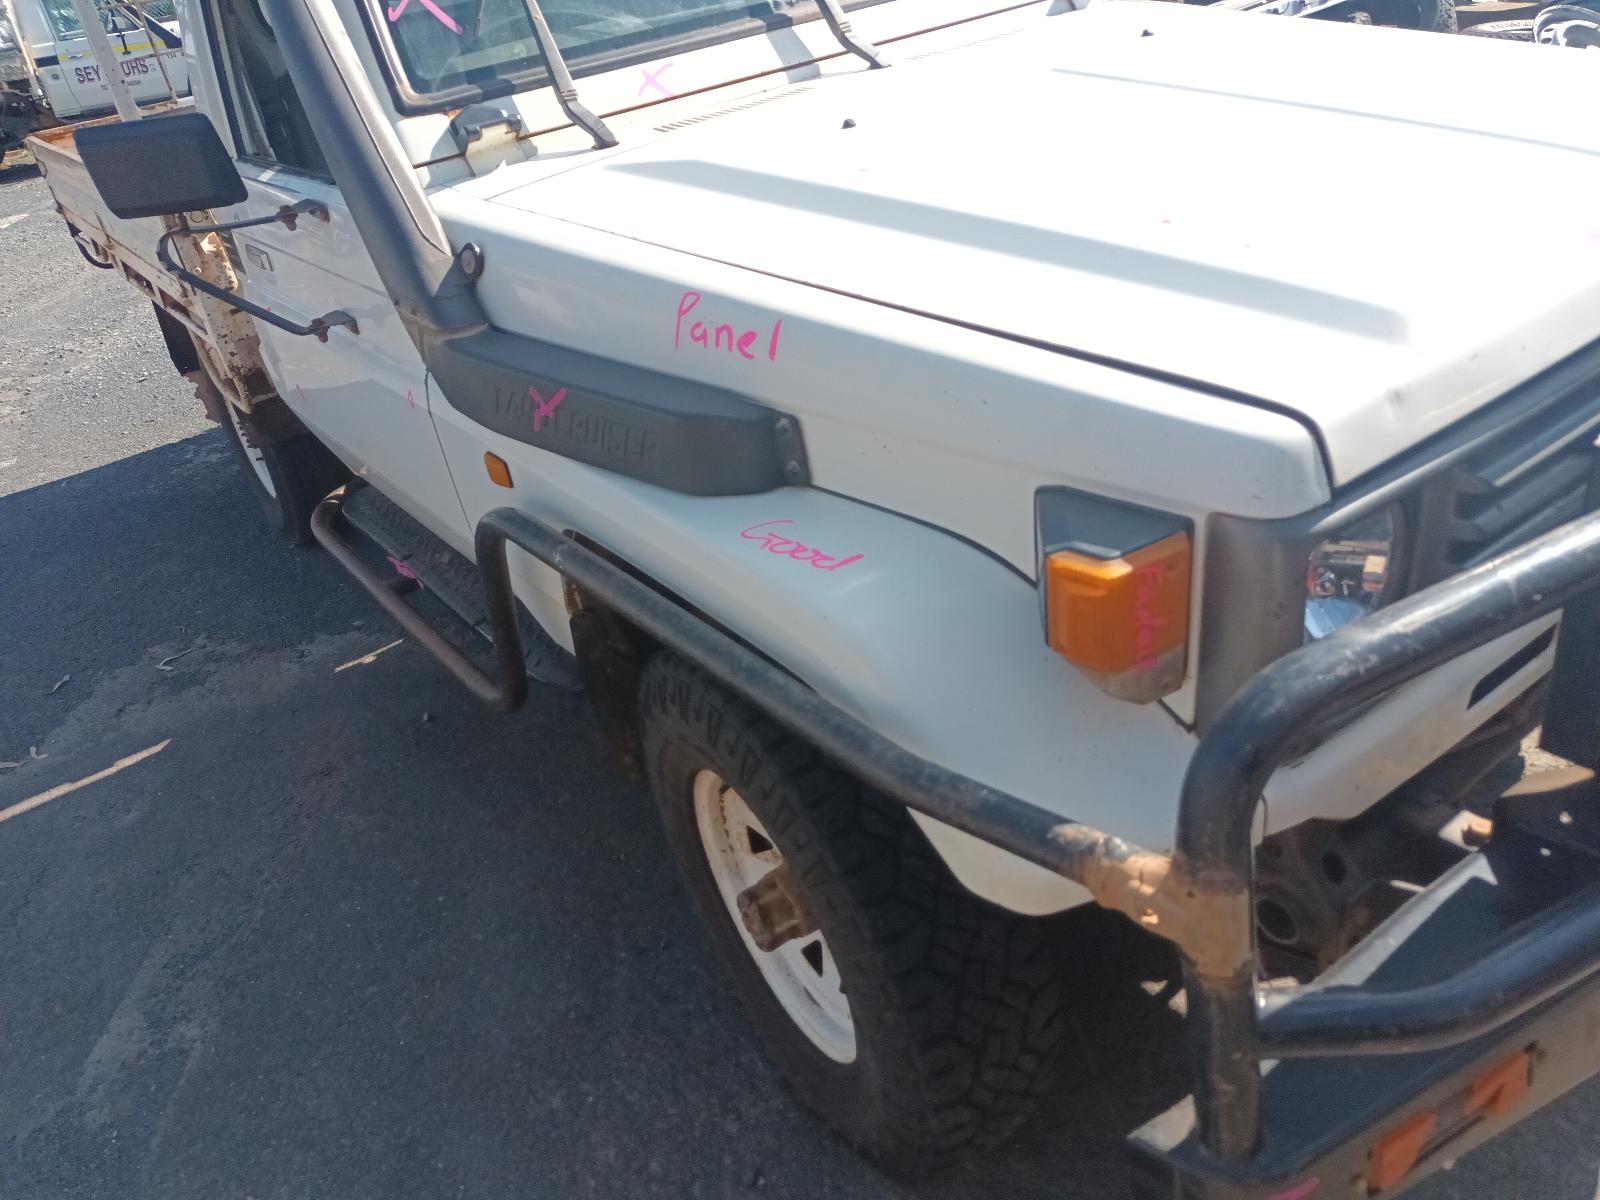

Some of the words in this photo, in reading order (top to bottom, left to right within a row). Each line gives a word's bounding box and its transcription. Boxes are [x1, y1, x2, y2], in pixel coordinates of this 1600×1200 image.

[75, 57, 149, 84] SEYURS
[674, 291, 782, 361] Panel
[740, 519, 864, 571] Good
